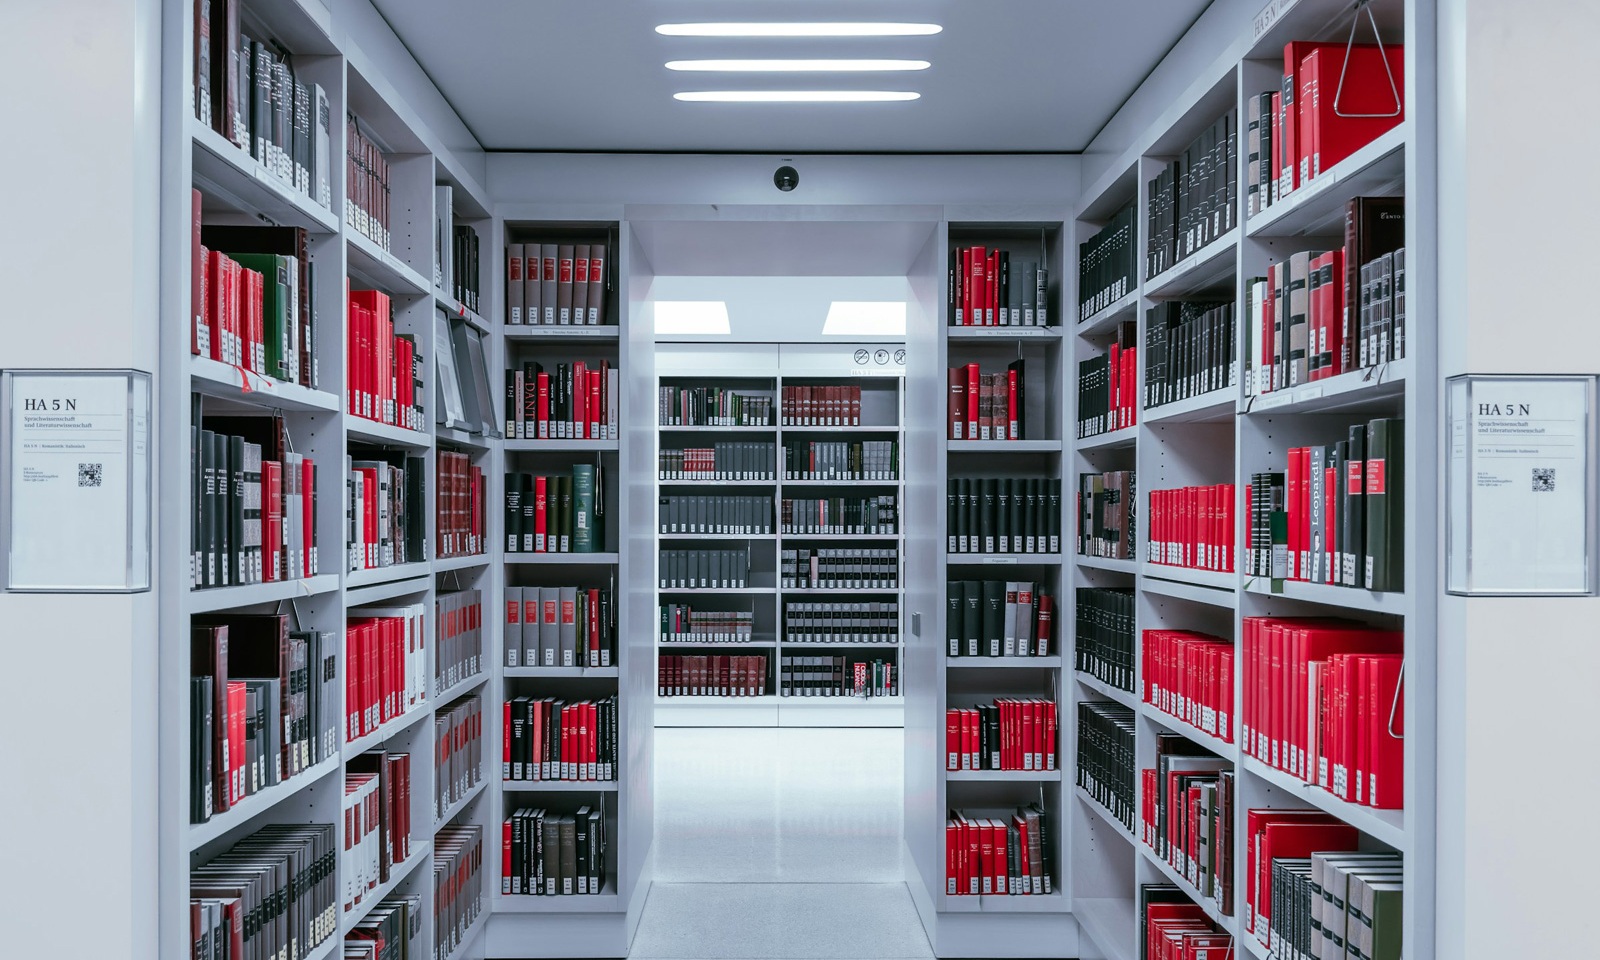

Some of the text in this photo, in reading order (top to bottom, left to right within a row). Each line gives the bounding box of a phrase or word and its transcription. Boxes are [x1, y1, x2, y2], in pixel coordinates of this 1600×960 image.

[1254, 17, 1265, 38] HA
[25, 399, 77, 411] HA 5 N
[525, 382, 536, 420] DANT
[1479, 403, 1530, 416] HA 5 N
[1312, 460, 1320, 526] Leopardi
